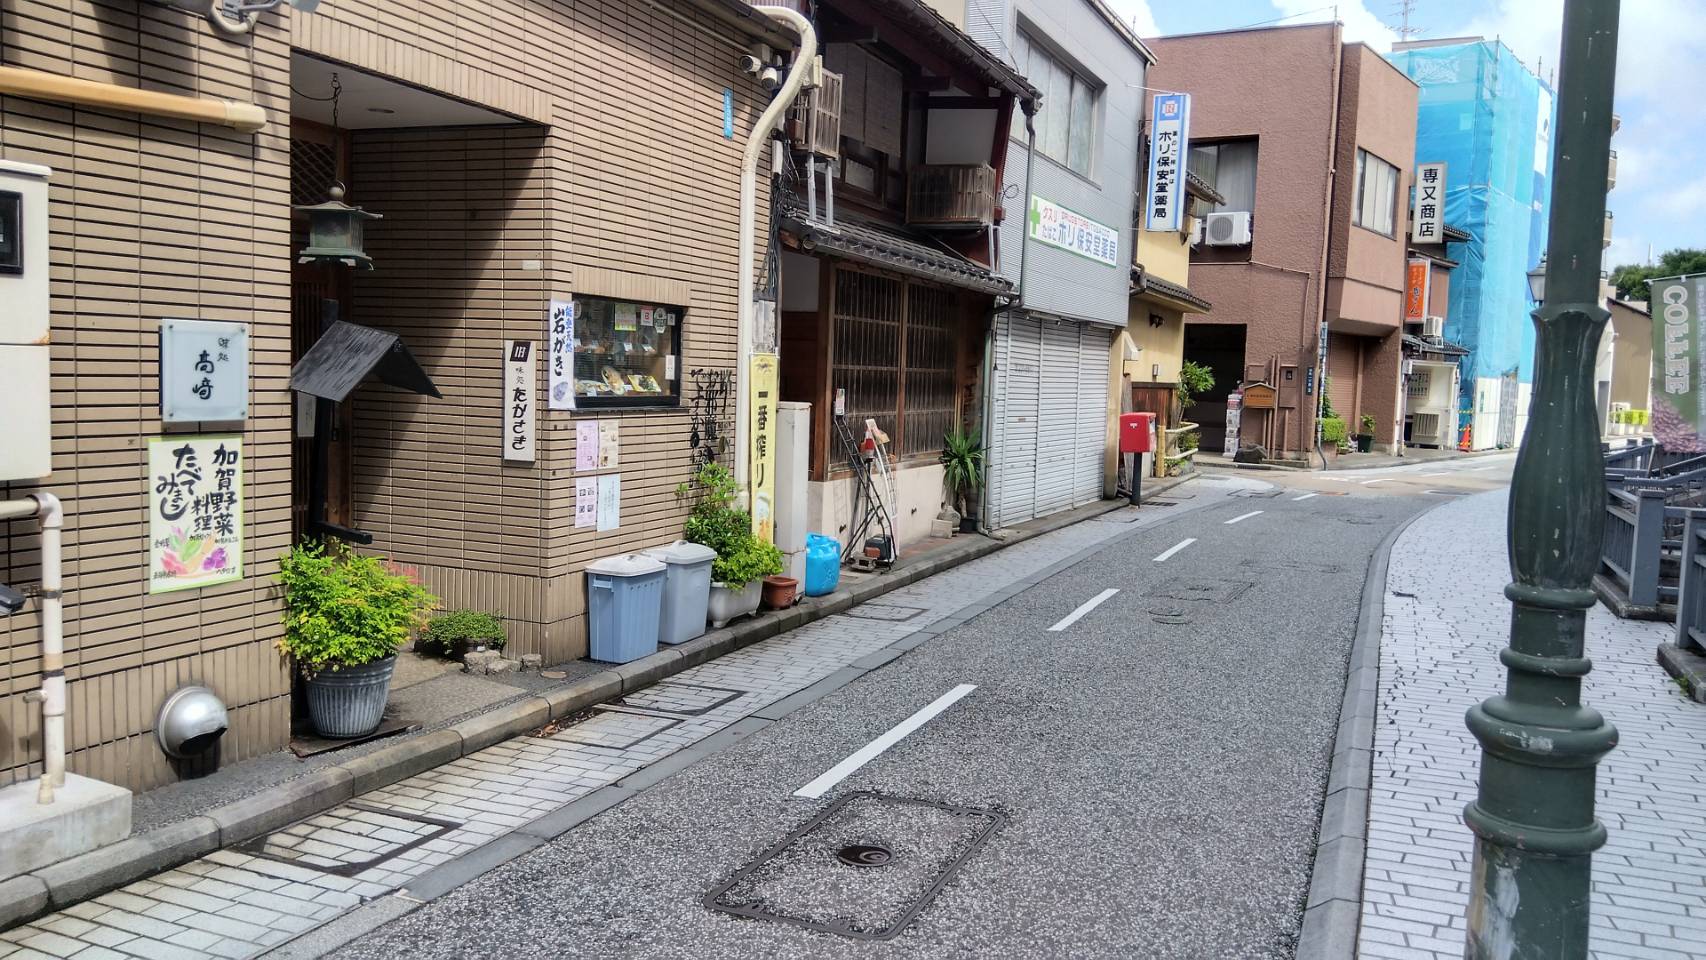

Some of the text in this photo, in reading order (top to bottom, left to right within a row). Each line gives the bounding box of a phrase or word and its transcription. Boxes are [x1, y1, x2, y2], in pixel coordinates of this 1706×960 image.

[1153, 131, 1172, 218] ホリ保安堂薬局
[1419, 168, 1439, 237] 専又商店
[552, 307, 566, 377] 岩がき
[1663, 285, 1690, 395] COFFEE
[512, 387, 527, 451] たかさき
[756, 391, 769, 488] 一番搾り
[210, 442, 239, 536] 加賀野菜
